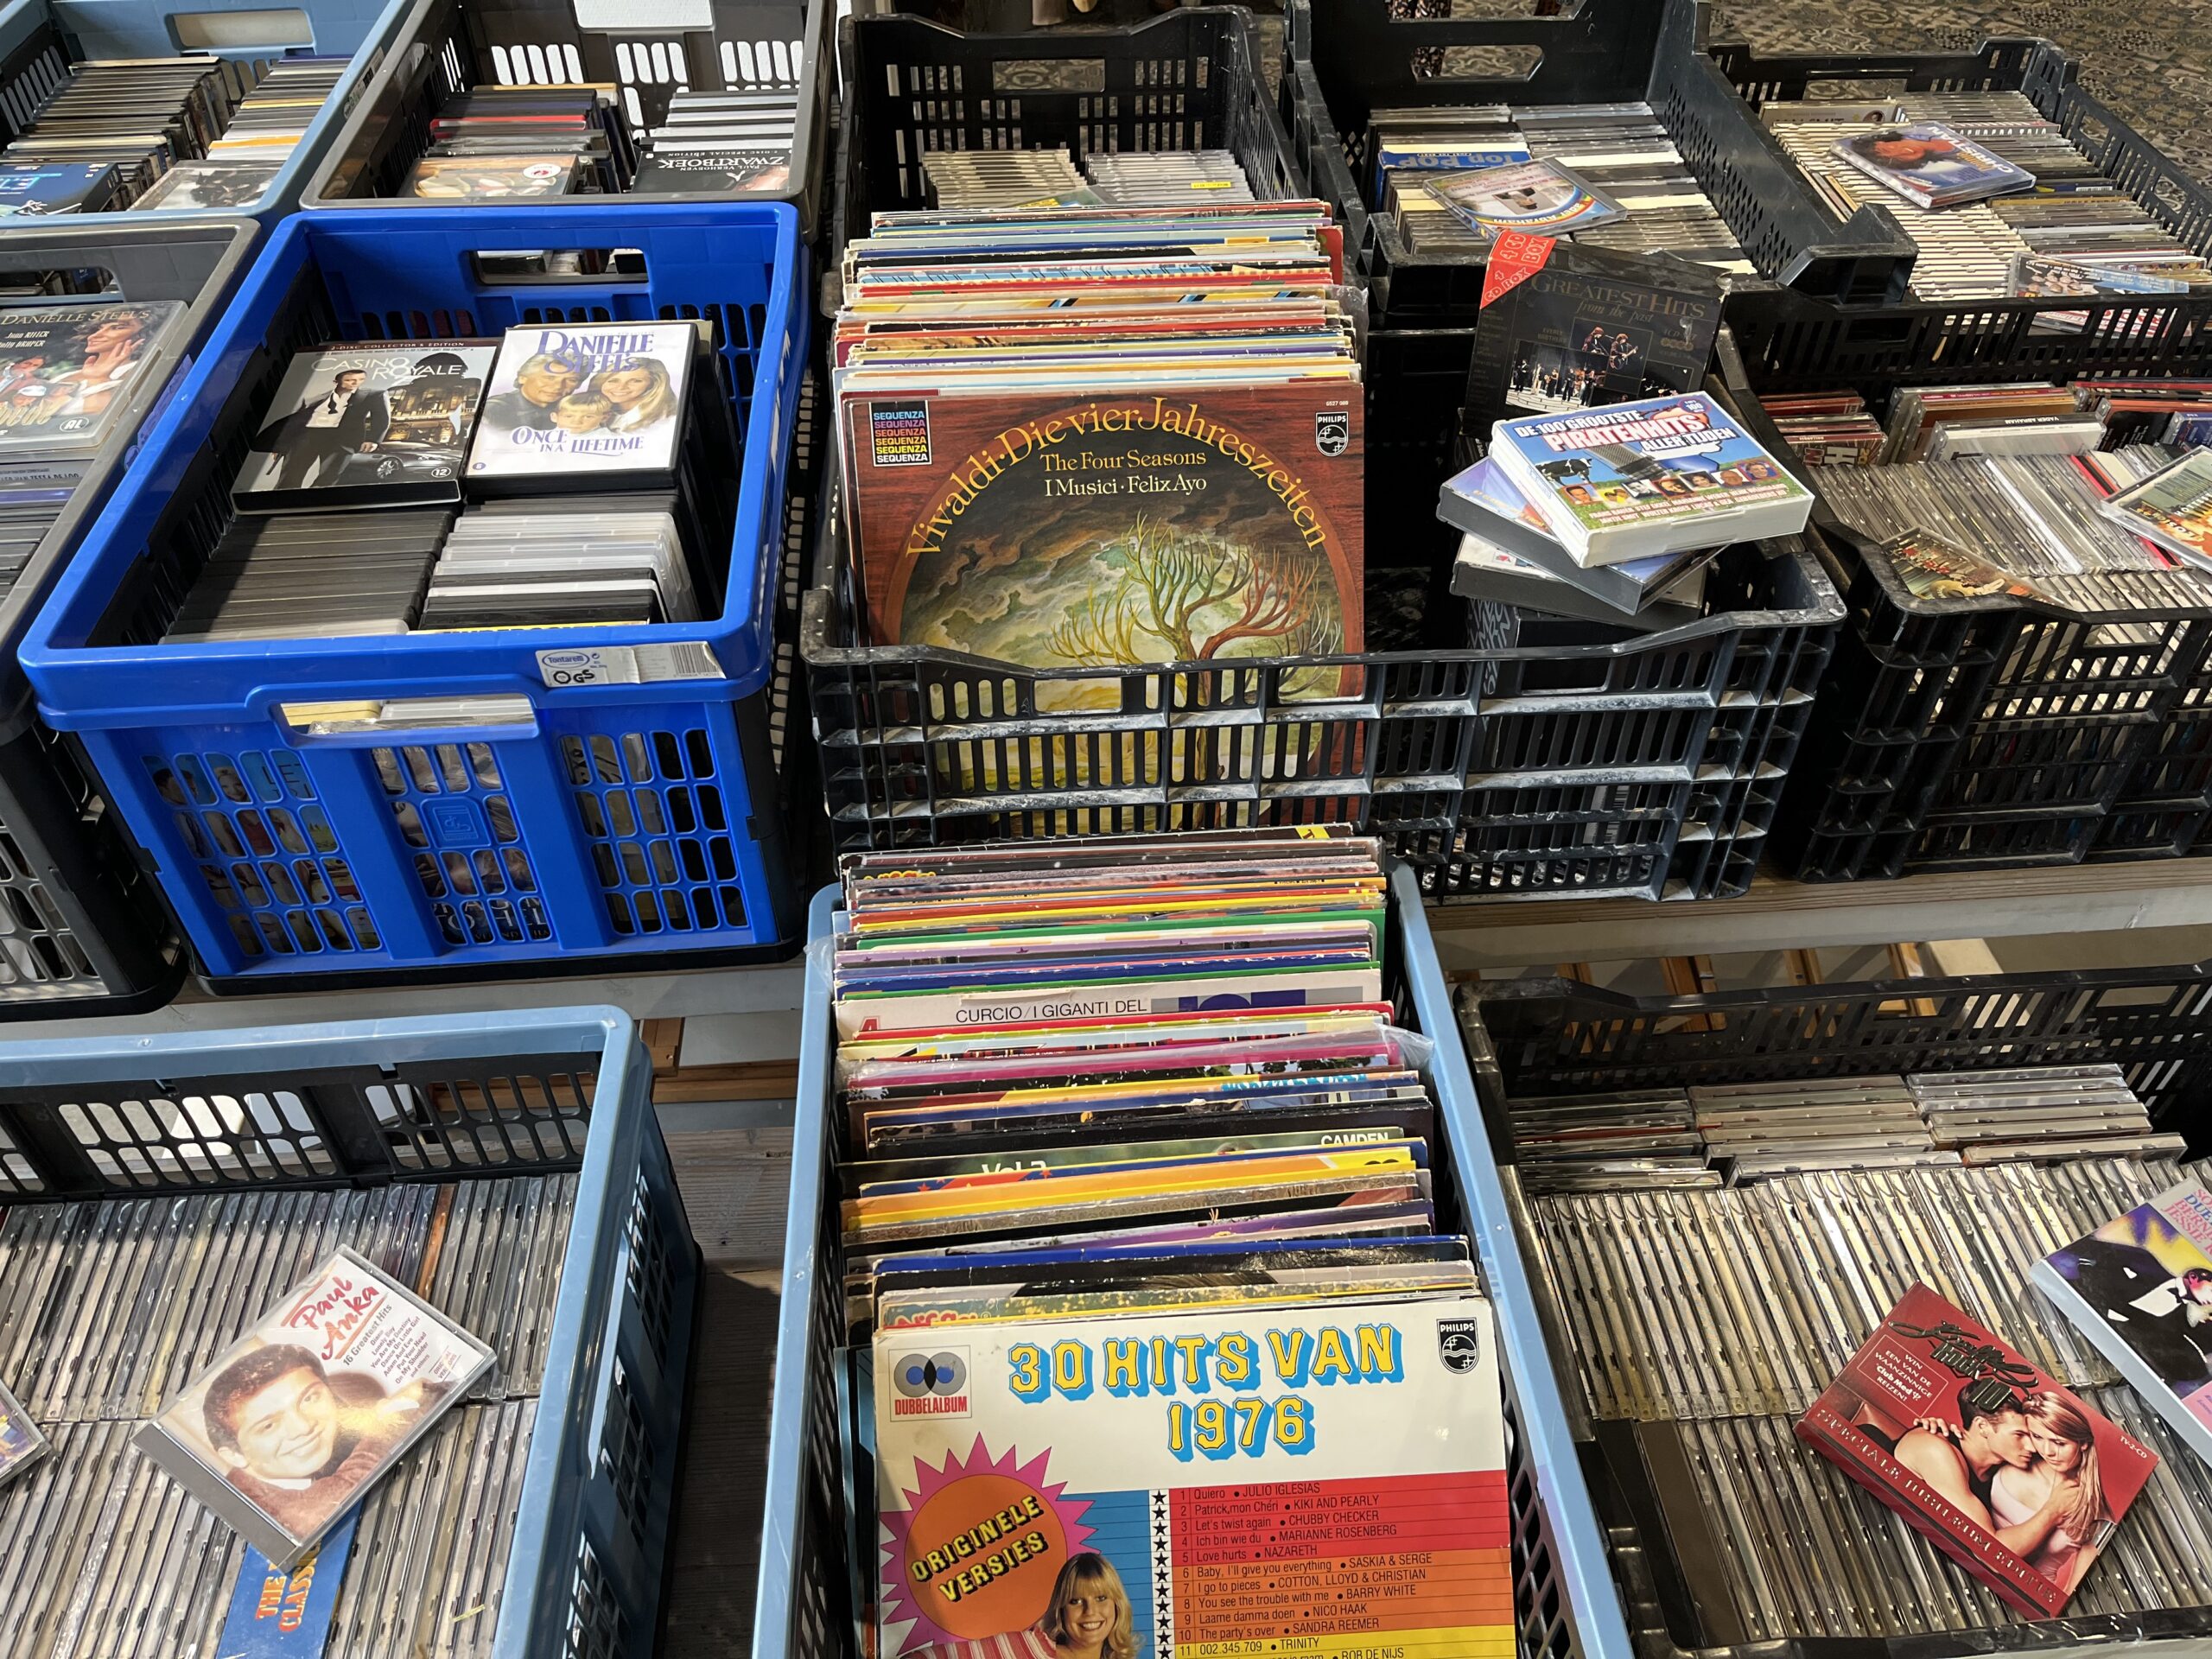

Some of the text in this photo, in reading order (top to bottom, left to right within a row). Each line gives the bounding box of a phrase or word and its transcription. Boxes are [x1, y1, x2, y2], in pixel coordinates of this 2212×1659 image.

[658, 156, 785, 169] ZWARTBOEK
[1398, 156, 1463, 168] POP
[1521, 237, 1549, 264] BOX
[1501, 267, 1532, 290] BOX
[1530, 273, 1707, 318] GREATEST HITS
[0, 309, 151, 326] DANIELLE STEEL'S
[537, 331, 655, 355] DANIELLE
[311, 357, 411, 372] CASINO
[544, 352, 640, 373] STEEL'S
[372, 365, 463, 382] ROYALE
[65, 418, 83, 429] AL
[873, 410, 925, 420] SEQUENZA
[874, 419, 925, 429] SEQUENZA
[1317, 415, 1347, 424] PHILIPS
[1536, 420, 1566, 434] 100
[1564, 409, 1645, 429] GROOTSTE
[512, 426, 567, 444] ONCE
[874, 428, 926, 437] SEQUENZA
[875, 436, 927, 446] SEQUENZA
[1542, 413, 1707, 452] PIRATENHITS
[571, 436, 645, 454] LIFETIME
[876, 445, 928, 454] SEQUENZA
[1640, 434, 1685, 453] ALLER
[876, 453, 928, 463] SEQUENZA
[1039, 448, 1207, 472] The Four Seasons
[435, 467, 448, 476] 12
[906, 396, 1327, 558] Vivaldi Die vier Jahreszeiten
[1044, 474, 1207, 497] I Musici Felix Ayo
[573, 669, 595, 683] GS
[1042, 1001, 1109, 1017] GIGANTI
[1116, 999, 1147, 1013] DEL
[1320, 1132, 1389, 1147] CAMDEN
[2184, 1193, 2212, 1225] DUE
[2163, 1205, 2207, 1244] JESSIE
[289, 1275, 353, 1331] Paul
[321, 1284, 380, 1362] Anka
[1440, 1322, 1476, 1332] PHILIPS
[342, 1303, 393, 1367] 16 Greatest Hits
[1007, 1322, 1406, 1404] 30 HITS VAN
[1885, 1350, 1932, 1389] EEN VAN DE
[1904, 1354, 1923, 1370] WIN
[1874, 1351, 1933, 1399] WAANZINNIGE
[1876, 1364, 1913, 1395] Club Med
[1876, 1376, 1908, 1402] REIZEN!
[894, 1395, 968, 1415] DUBBELALBUM
[1166, 1394, 1317, 1463] 1976
[1816, 1408, 1903, 1479] SPECIALE
[2120, 1435, 2148, 1459] TV-2-CD
[1194, 1483, 1320, 1501] Quiero JULIO IGLESIAS
[1253, 1499, 1279, 1512] Chéri
[1294, 1499, 1313, 1510] KIKI
[1316, 1497, 1338, 1509] AND
[1340, 1495, 1381, 1507] PEARLY
[1195, 1510, 1380, 1531] Let's twist again CHUBBY CHECKER
[911, 1496, 1045, 1582] ORIGINELE
[1196, 1524, 1398, 1547] Ich bin wie du MARIANNE ROSENBERG
[1196, 1545, 1319, 1562] Love hurts NAZARETH
[938, 1531, 1049, 1602] VERSIES
[1198, 1553, 1433, 1580] Baby, give you everything SASKIA & SERGE
[1204, 1583, 1217, 1596] go
[1218, 1581, 1229, 1592] to
[1230, 1580, 1262, 1593] pieces
[1325, 1573, 1359, 1586] LLOYD
[1362, 1572, 1370, 1583] &
[1371, 1568, 1427, 1582] CHRISTIAN
[256, 1575, 288, 1621] THE
[1198, 1584, 1417, 1609] You see the trouble with me BARRY WHITE
[1234, 1602, 1368, 1622] damma doen NICO HAAK
[1179, 1618, 1380, 1641] 10 The party's over SANDRA REEMER
[1179, 1645, 1192, 1656] 11
[1199, 1640, 1262, 1656] 002.345.709
[1280, 1637, 1320, 1650] TRINITY
[1365, 1647, 1405, 1659] DE NIJS
